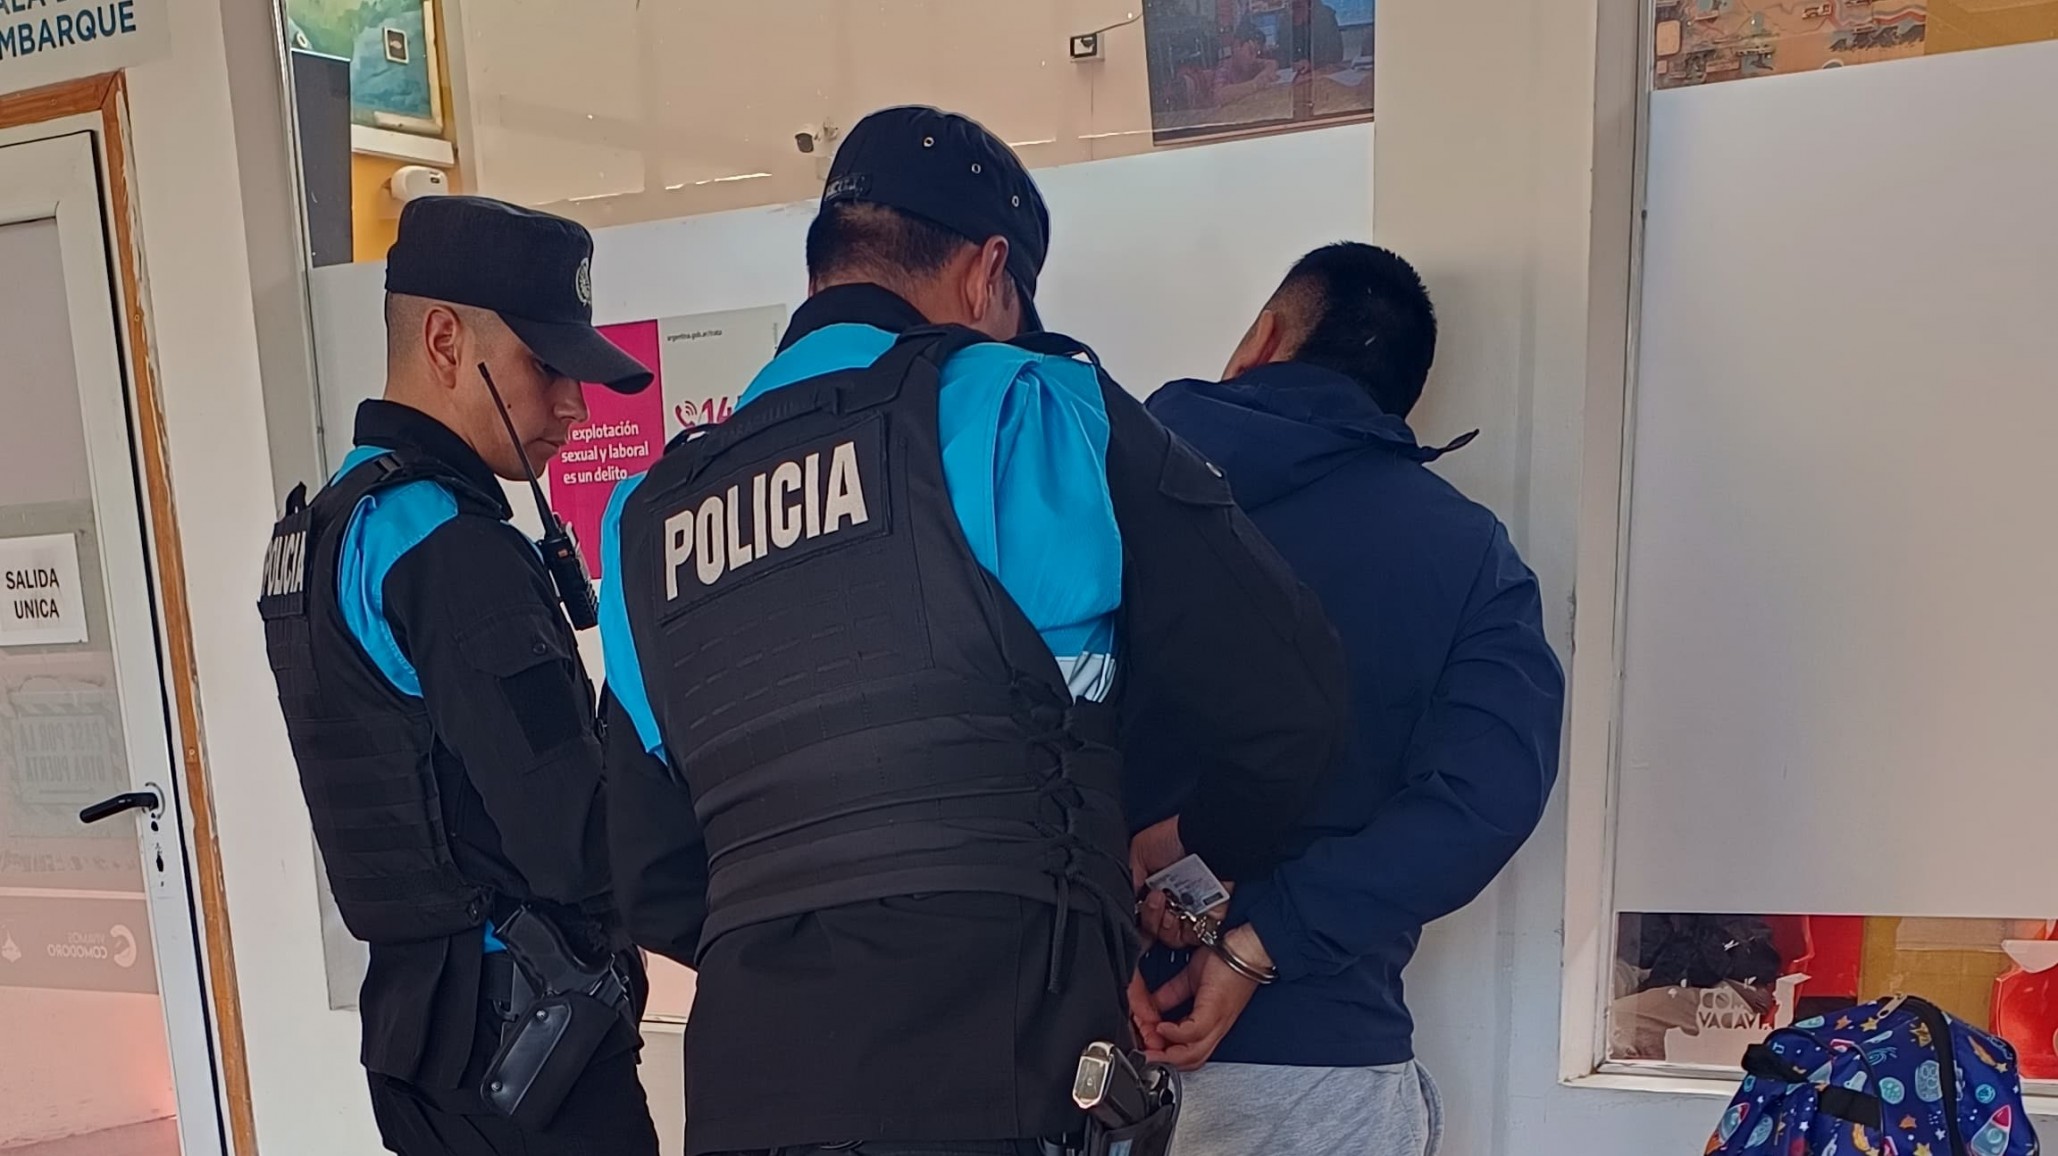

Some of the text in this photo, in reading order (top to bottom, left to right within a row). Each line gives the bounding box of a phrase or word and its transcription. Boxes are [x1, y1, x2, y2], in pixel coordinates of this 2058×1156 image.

[0, 0, 137, 60] MBARQUE
[701, 396, 742, 424] 14
[572, 421, 639, 443] explotación
[561, 441, 649, 463] sexual y laboral
[563, 466, 628, 485] es un delito
[665, 441, 869, 601] POLICIA
[261, 531, 307, 597] POLICIA
[5, 568, 60, 590] SALIDA
[13, 598, 60, 619] UNICA
